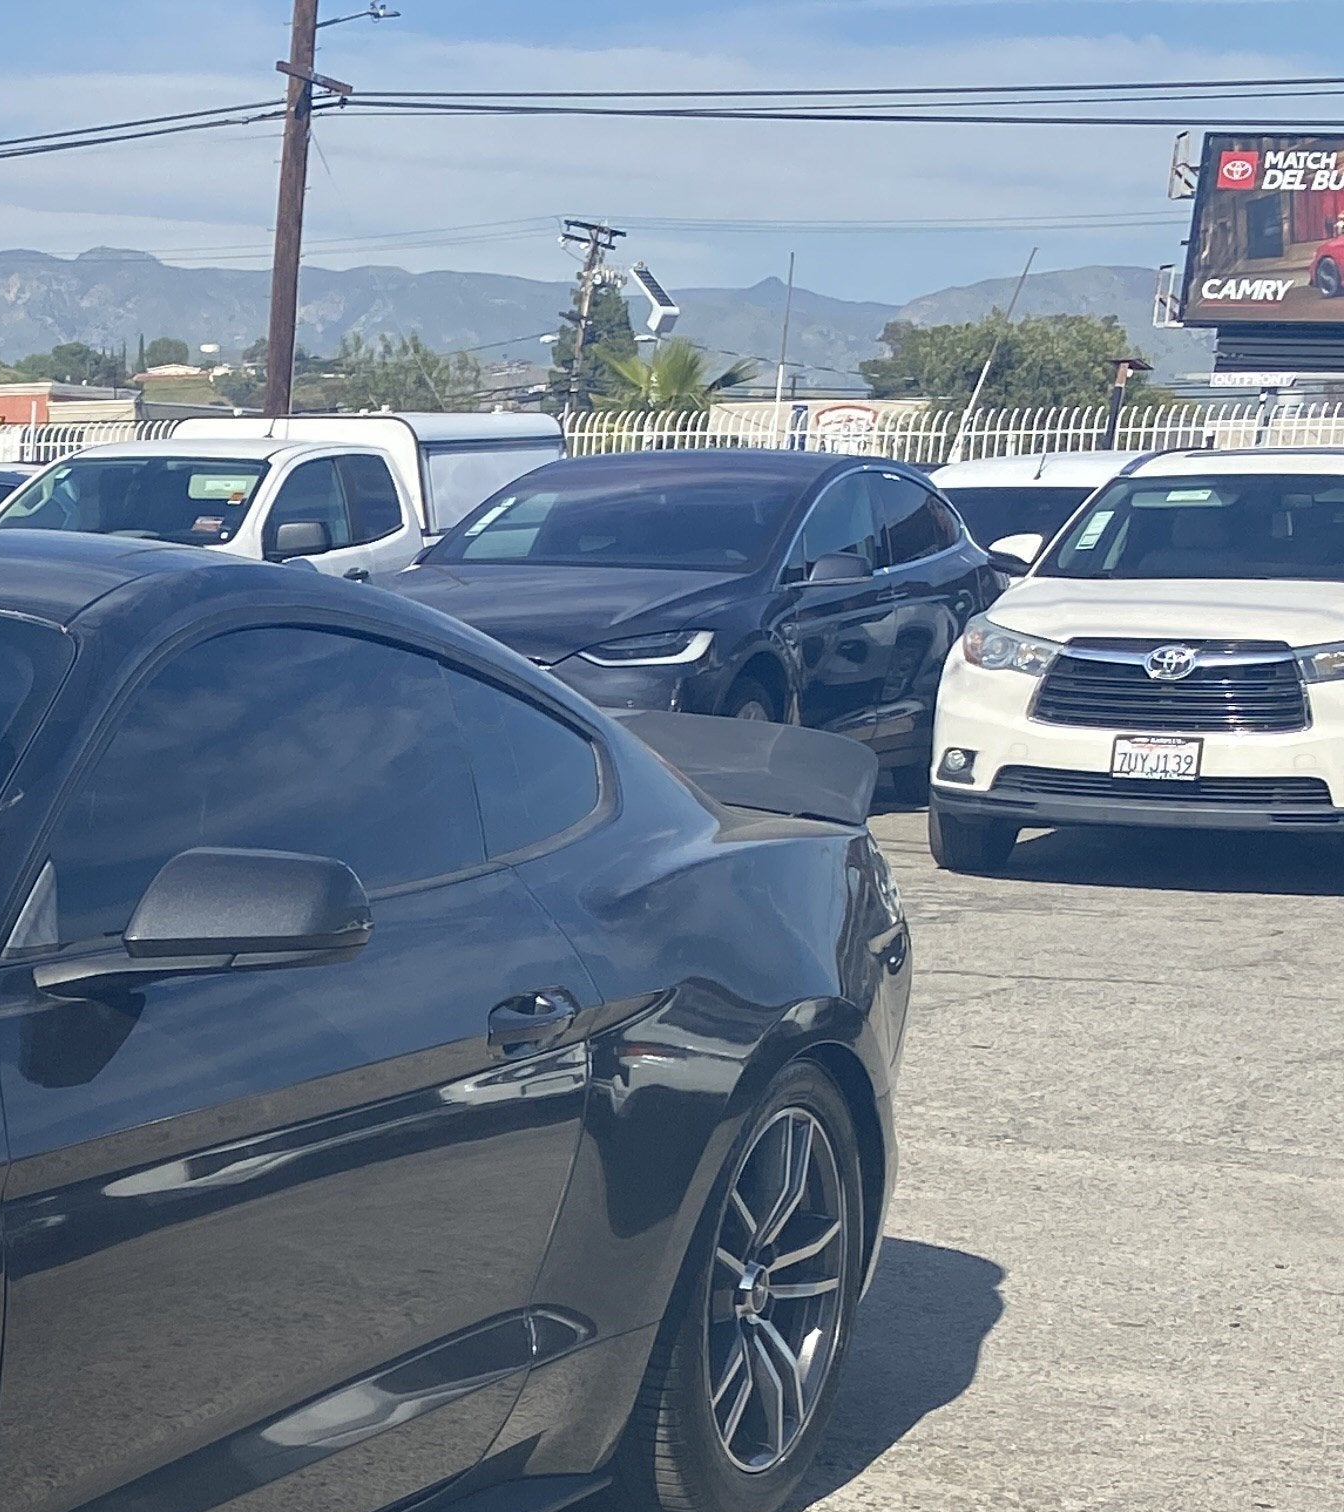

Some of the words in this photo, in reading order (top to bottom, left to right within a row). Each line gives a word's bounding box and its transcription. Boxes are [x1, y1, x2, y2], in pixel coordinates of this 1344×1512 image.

[1264, 150, 1338, 169] MATCH
[1261, 169, 1307, 190] DEL
[1201, 278, 1295, 301] CAMRY
[1118, 752, 1194, 775] 7UYJ139
